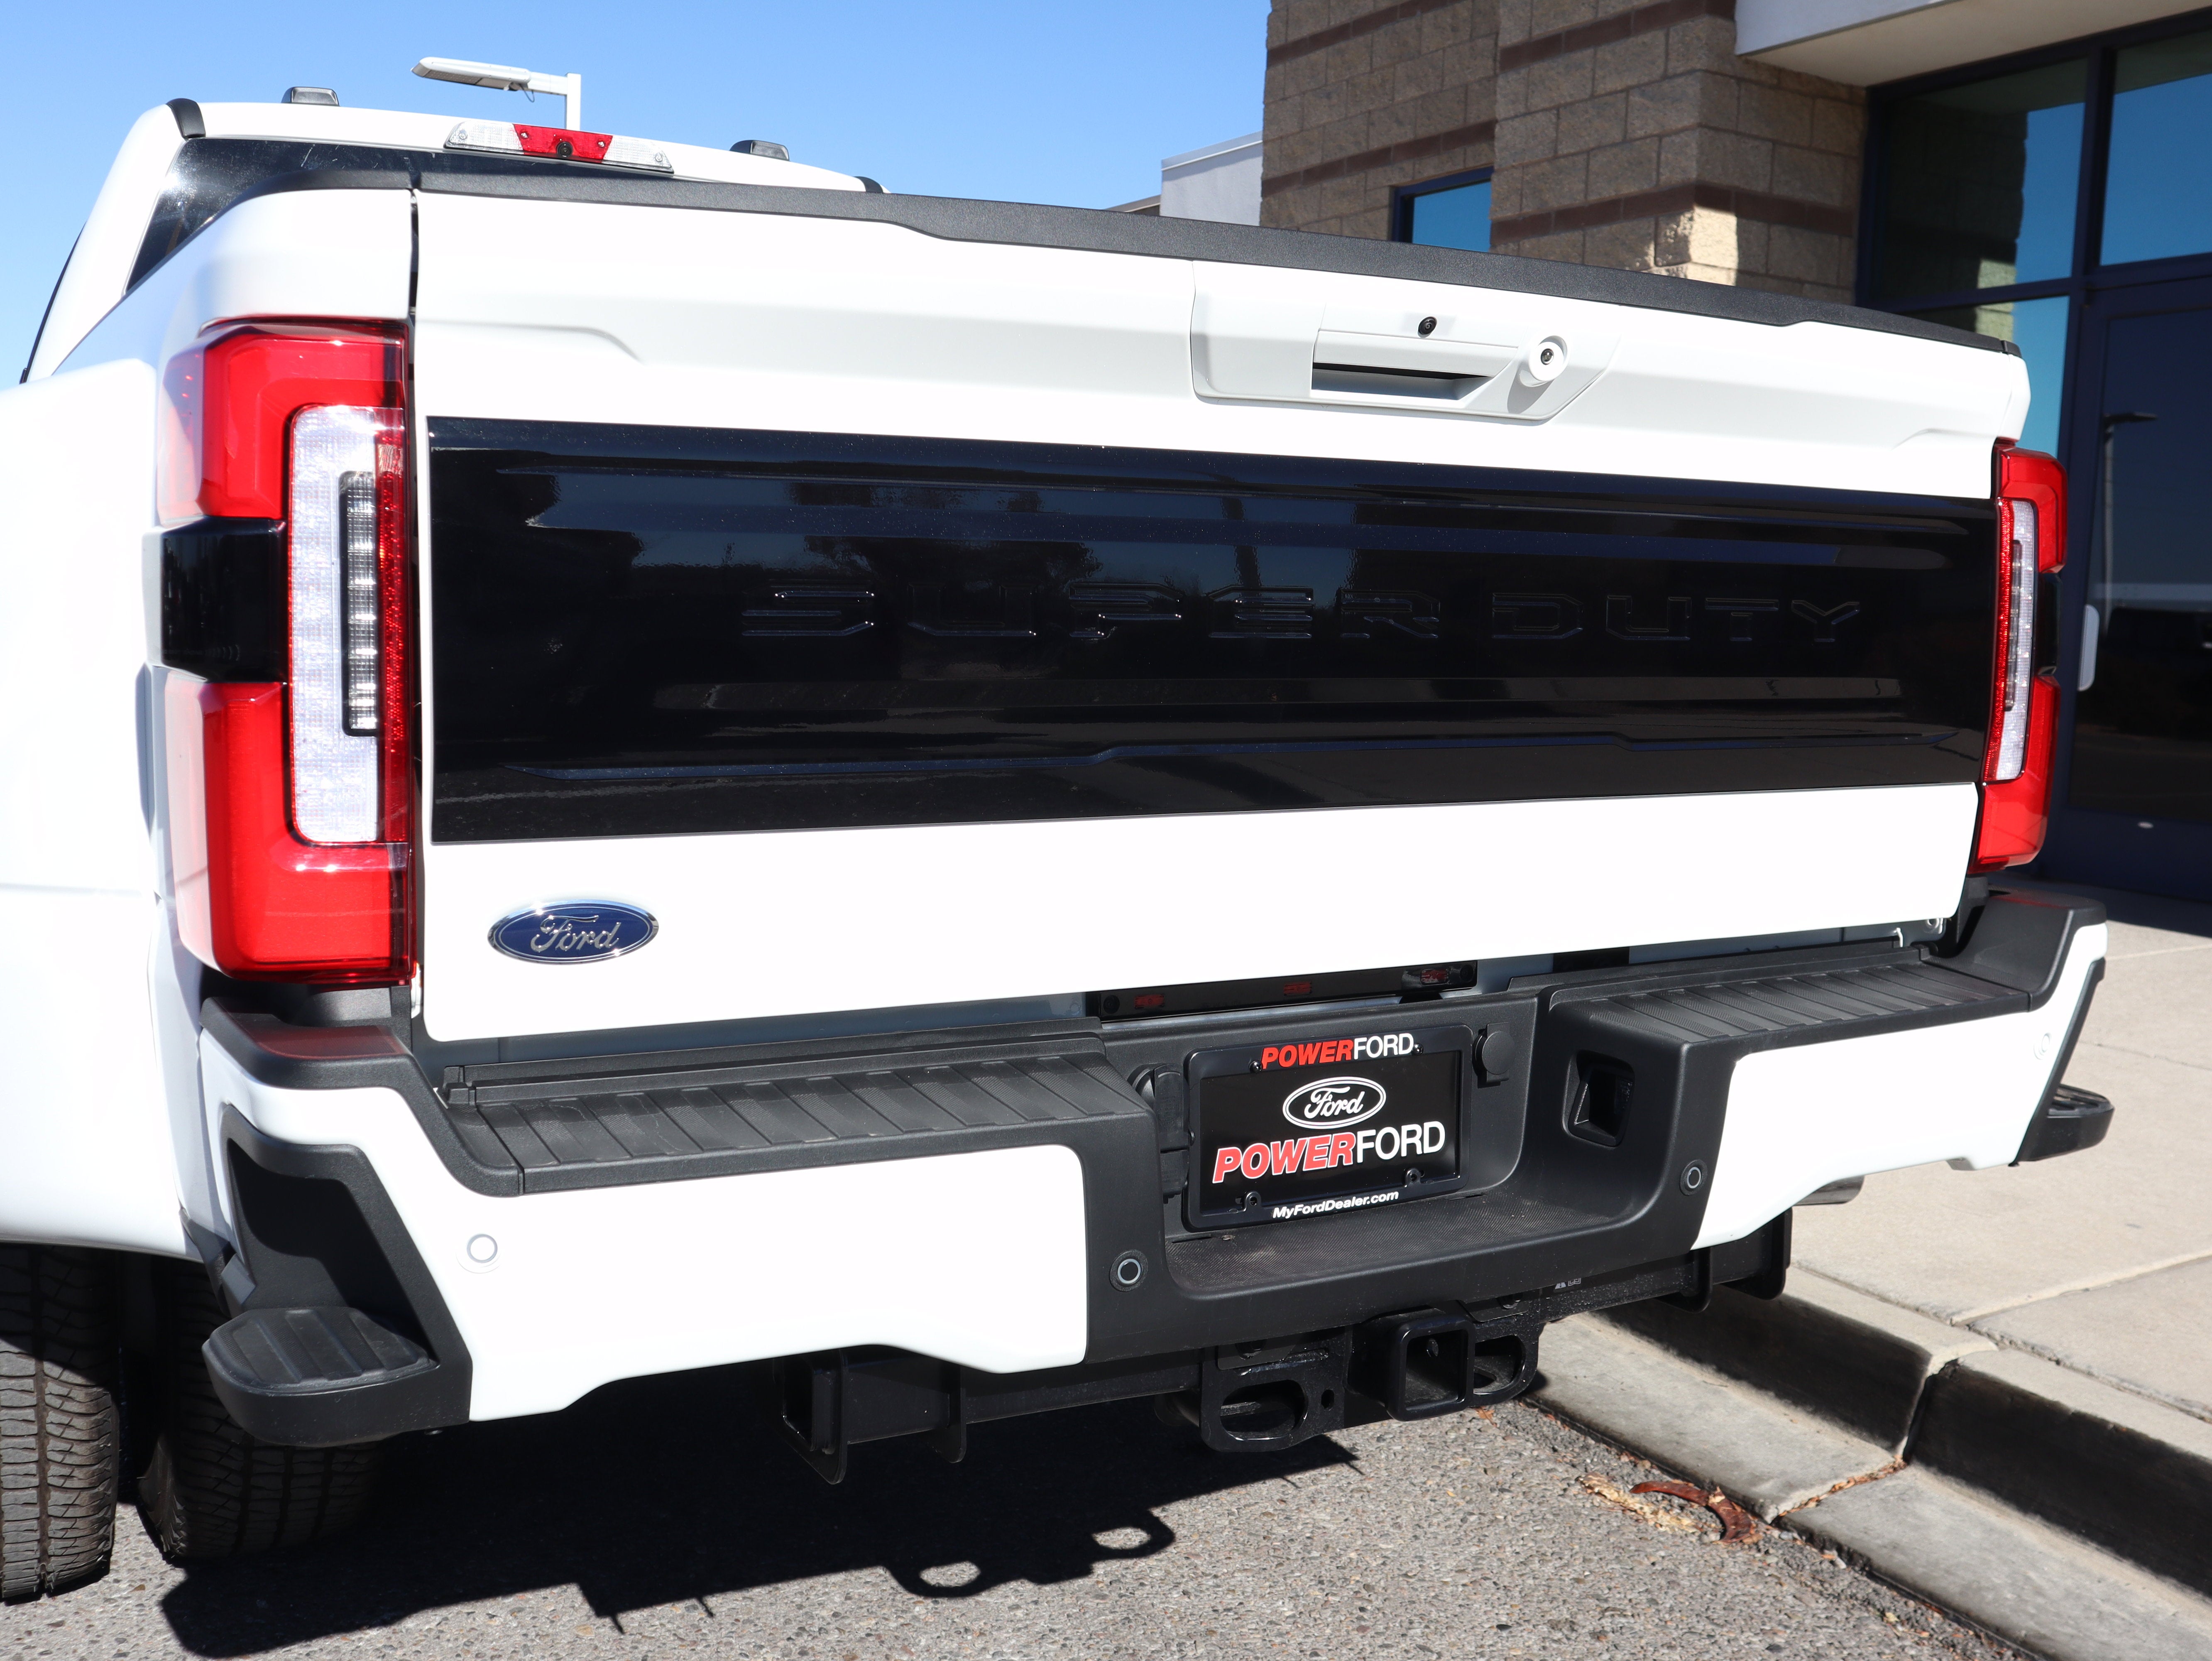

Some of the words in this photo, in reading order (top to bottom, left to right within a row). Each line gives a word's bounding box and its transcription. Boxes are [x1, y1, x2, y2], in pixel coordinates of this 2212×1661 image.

[741, 578, 1441, 639] SUPER
[1492, 593, 1861, 642] DUTY
[530, 915, 622, 953] Ford
[1304, 1085, 1365, 1119] Ford
[1272, 1190, 1399, 1219] MyFordDealer.com
